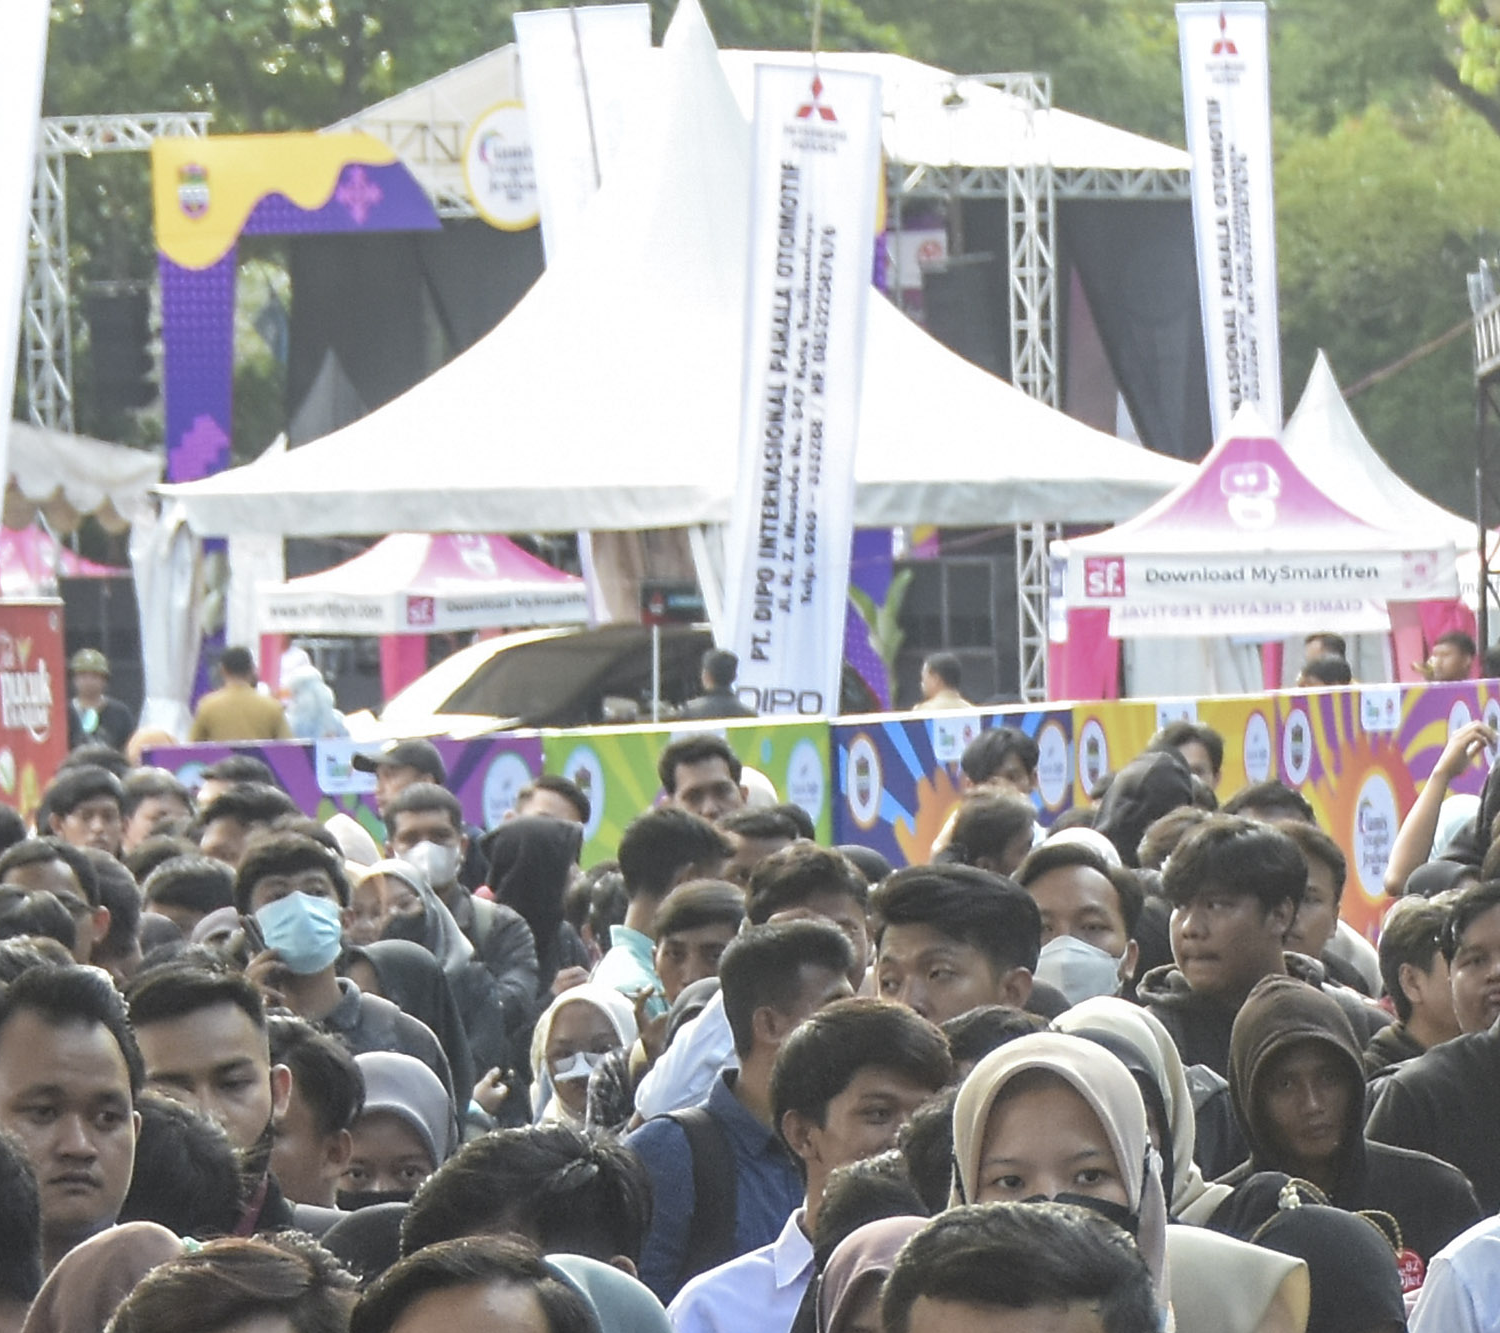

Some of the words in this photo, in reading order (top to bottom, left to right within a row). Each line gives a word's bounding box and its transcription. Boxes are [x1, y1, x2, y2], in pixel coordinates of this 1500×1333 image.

[775, 161, 800, 278] OTOMOTIF
[758, 383, 787, 558] INTERNASIONAL
[753, 568, 775, 622] DIPO
[1144, 564, 1245, 584] Download
[1251, 563, 1380, 585] MySmartfren
[735, 687, 822, 715] DIPO
